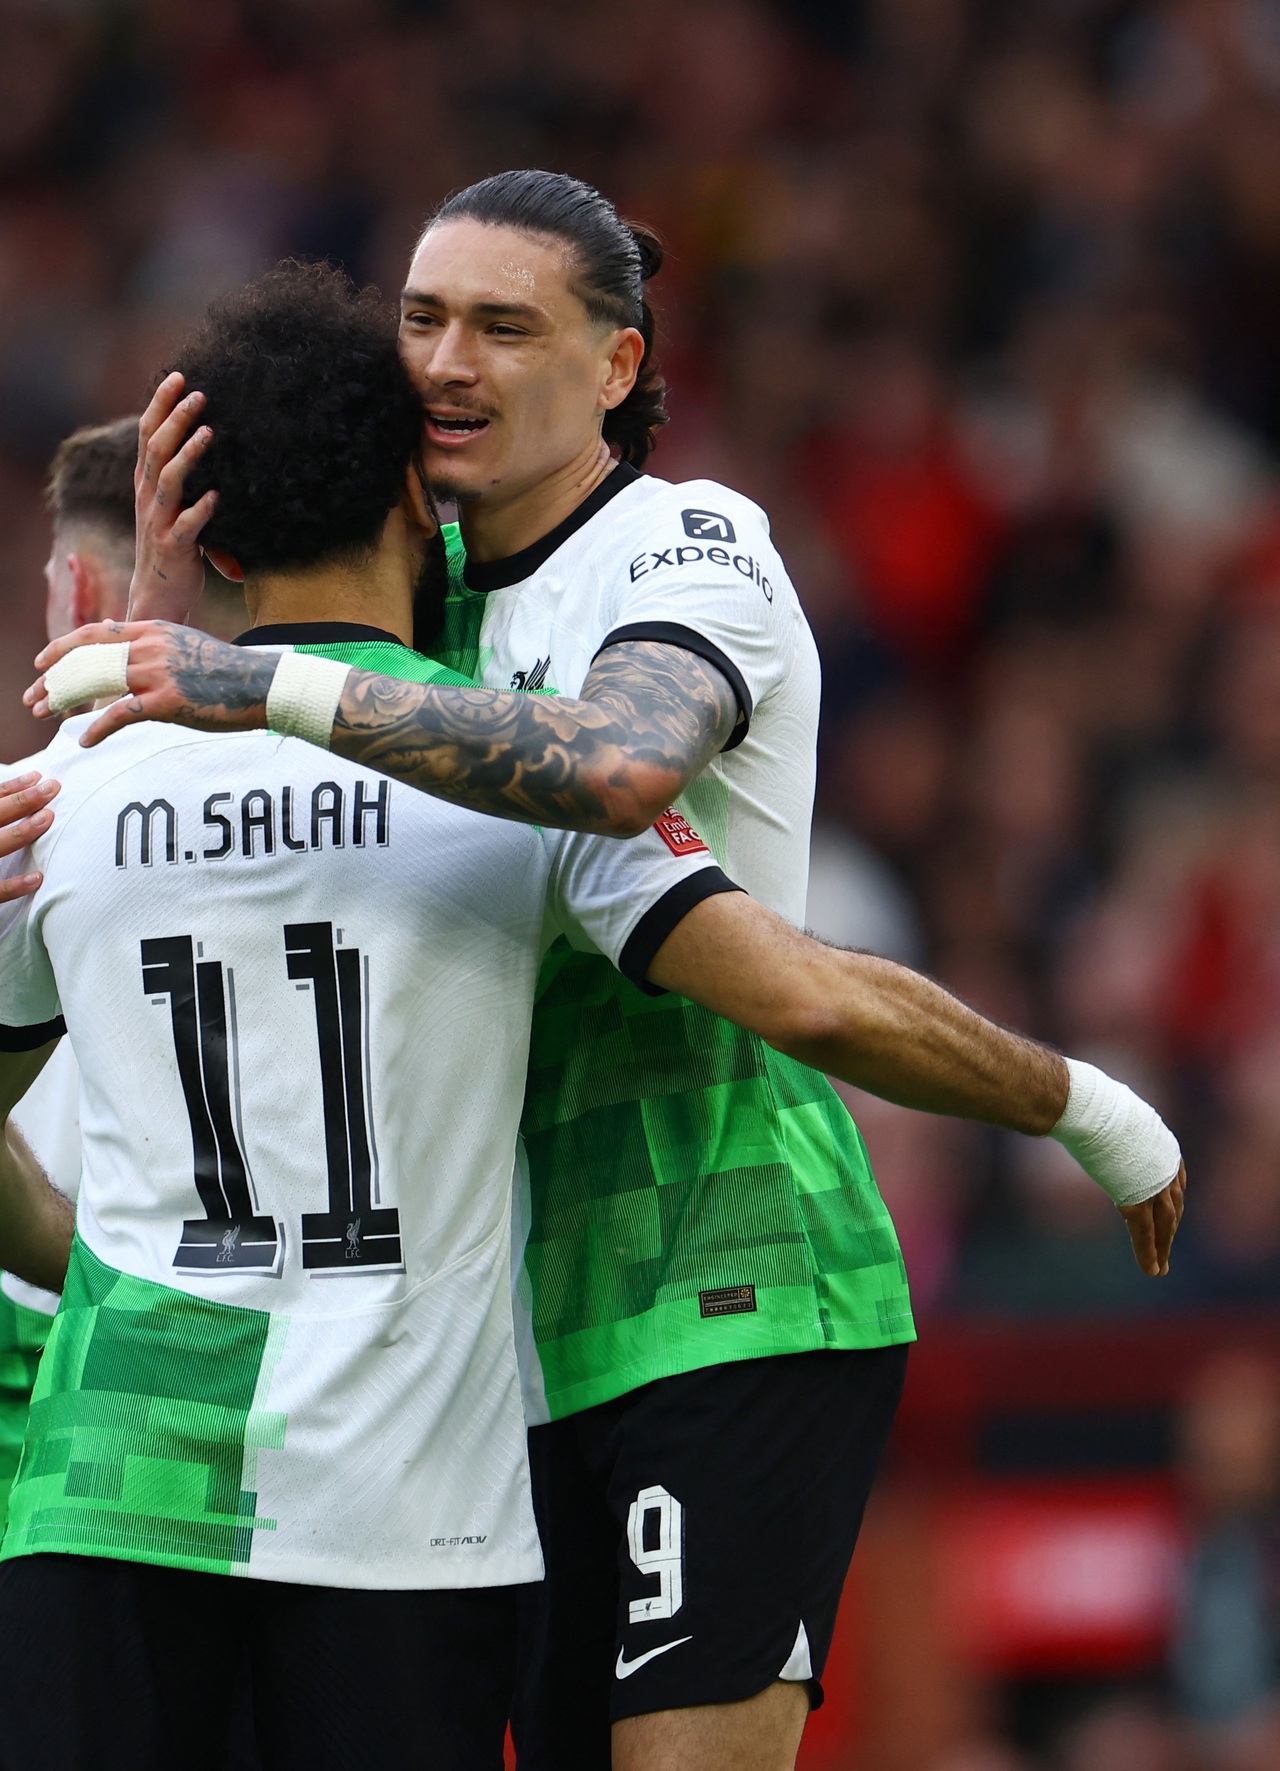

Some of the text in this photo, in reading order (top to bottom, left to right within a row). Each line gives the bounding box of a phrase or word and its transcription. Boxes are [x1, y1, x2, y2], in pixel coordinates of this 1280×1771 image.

[630, 546, 773, 606] Expedia
[671, 831, 693, 844] FA
[140, 921, 404, 1273] 11
[626, 1484, 684, 1625] 9
